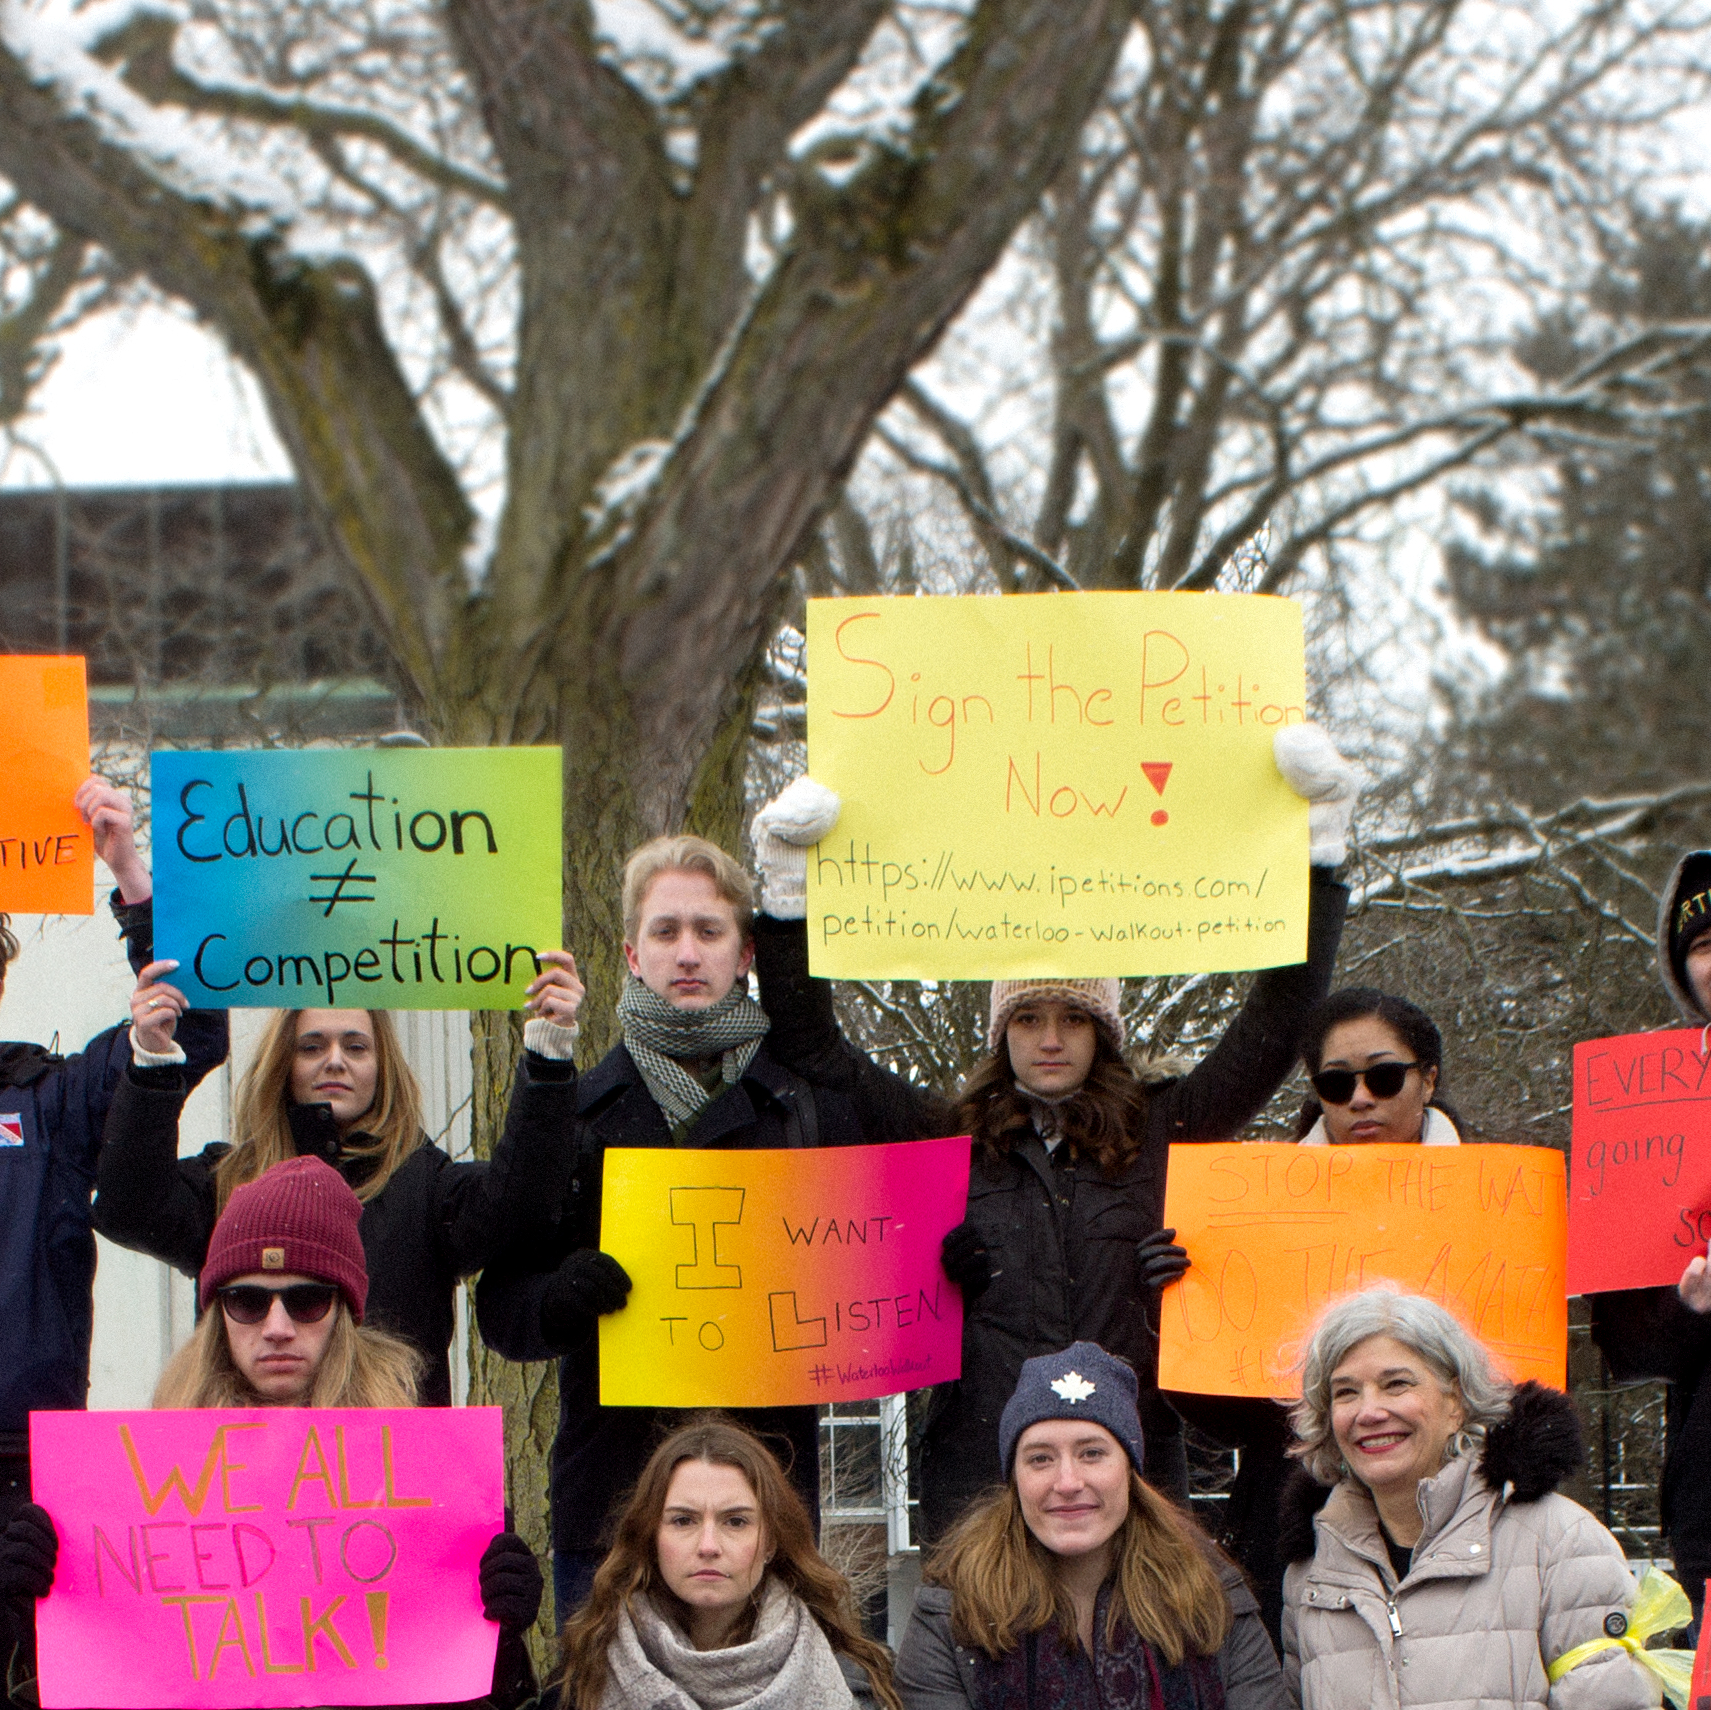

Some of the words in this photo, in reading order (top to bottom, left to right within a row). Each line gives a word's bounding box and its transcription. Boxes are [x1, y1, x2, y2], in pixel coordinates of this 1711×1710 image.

[832, 613, 993, 775] Sign
[1017, 641, 1115, 726] the
[1140, 630, 1305, 726] Petition
[176, 770, 499, 863] Education
[193, 918, 543, 1005] Competition
[1208, 1151, 1353, 1203] STOP
[1378, 1158, 1456, 1211] THE
[1587, 1133, 1686, 1197] going
[670, 1187, 745, 1289] I
[783, 1216, 892, 1246] WANT
[660, 1318, 724, 1351] TO
[768, 1282, 942, 1352] LISTEN
[1178, 1249, 1258, 1342] DO
[118, 1422, 268, 1516] WE
[287, 1424, 432, 1511] ALL
[93, 1521, 276, 1597] NEED
[286, 1518, 397, 1584] TO
[161, 1591, 390, 1681] TALK!
